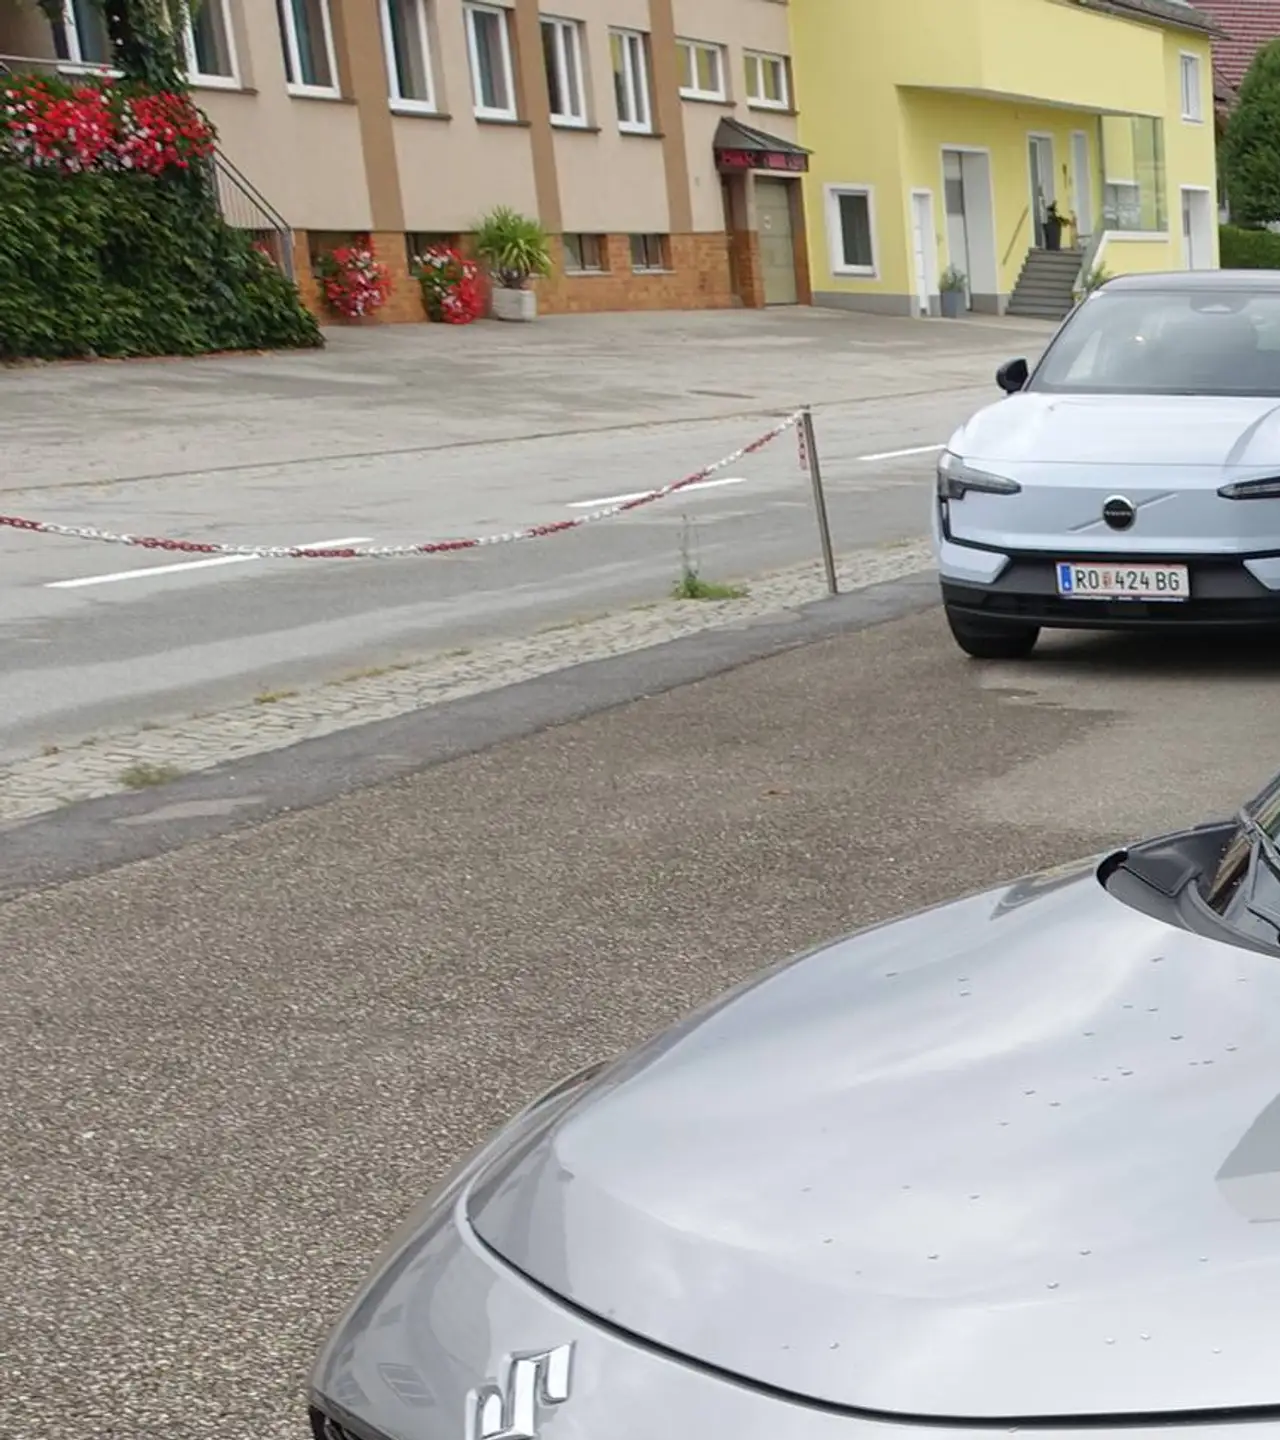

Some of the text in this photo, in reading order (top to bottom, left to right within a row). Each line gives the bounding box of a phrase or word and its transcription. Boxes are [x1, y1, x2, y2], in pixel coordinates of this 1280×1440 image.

[1075, 569, 1180, 592] RO 424 BG
